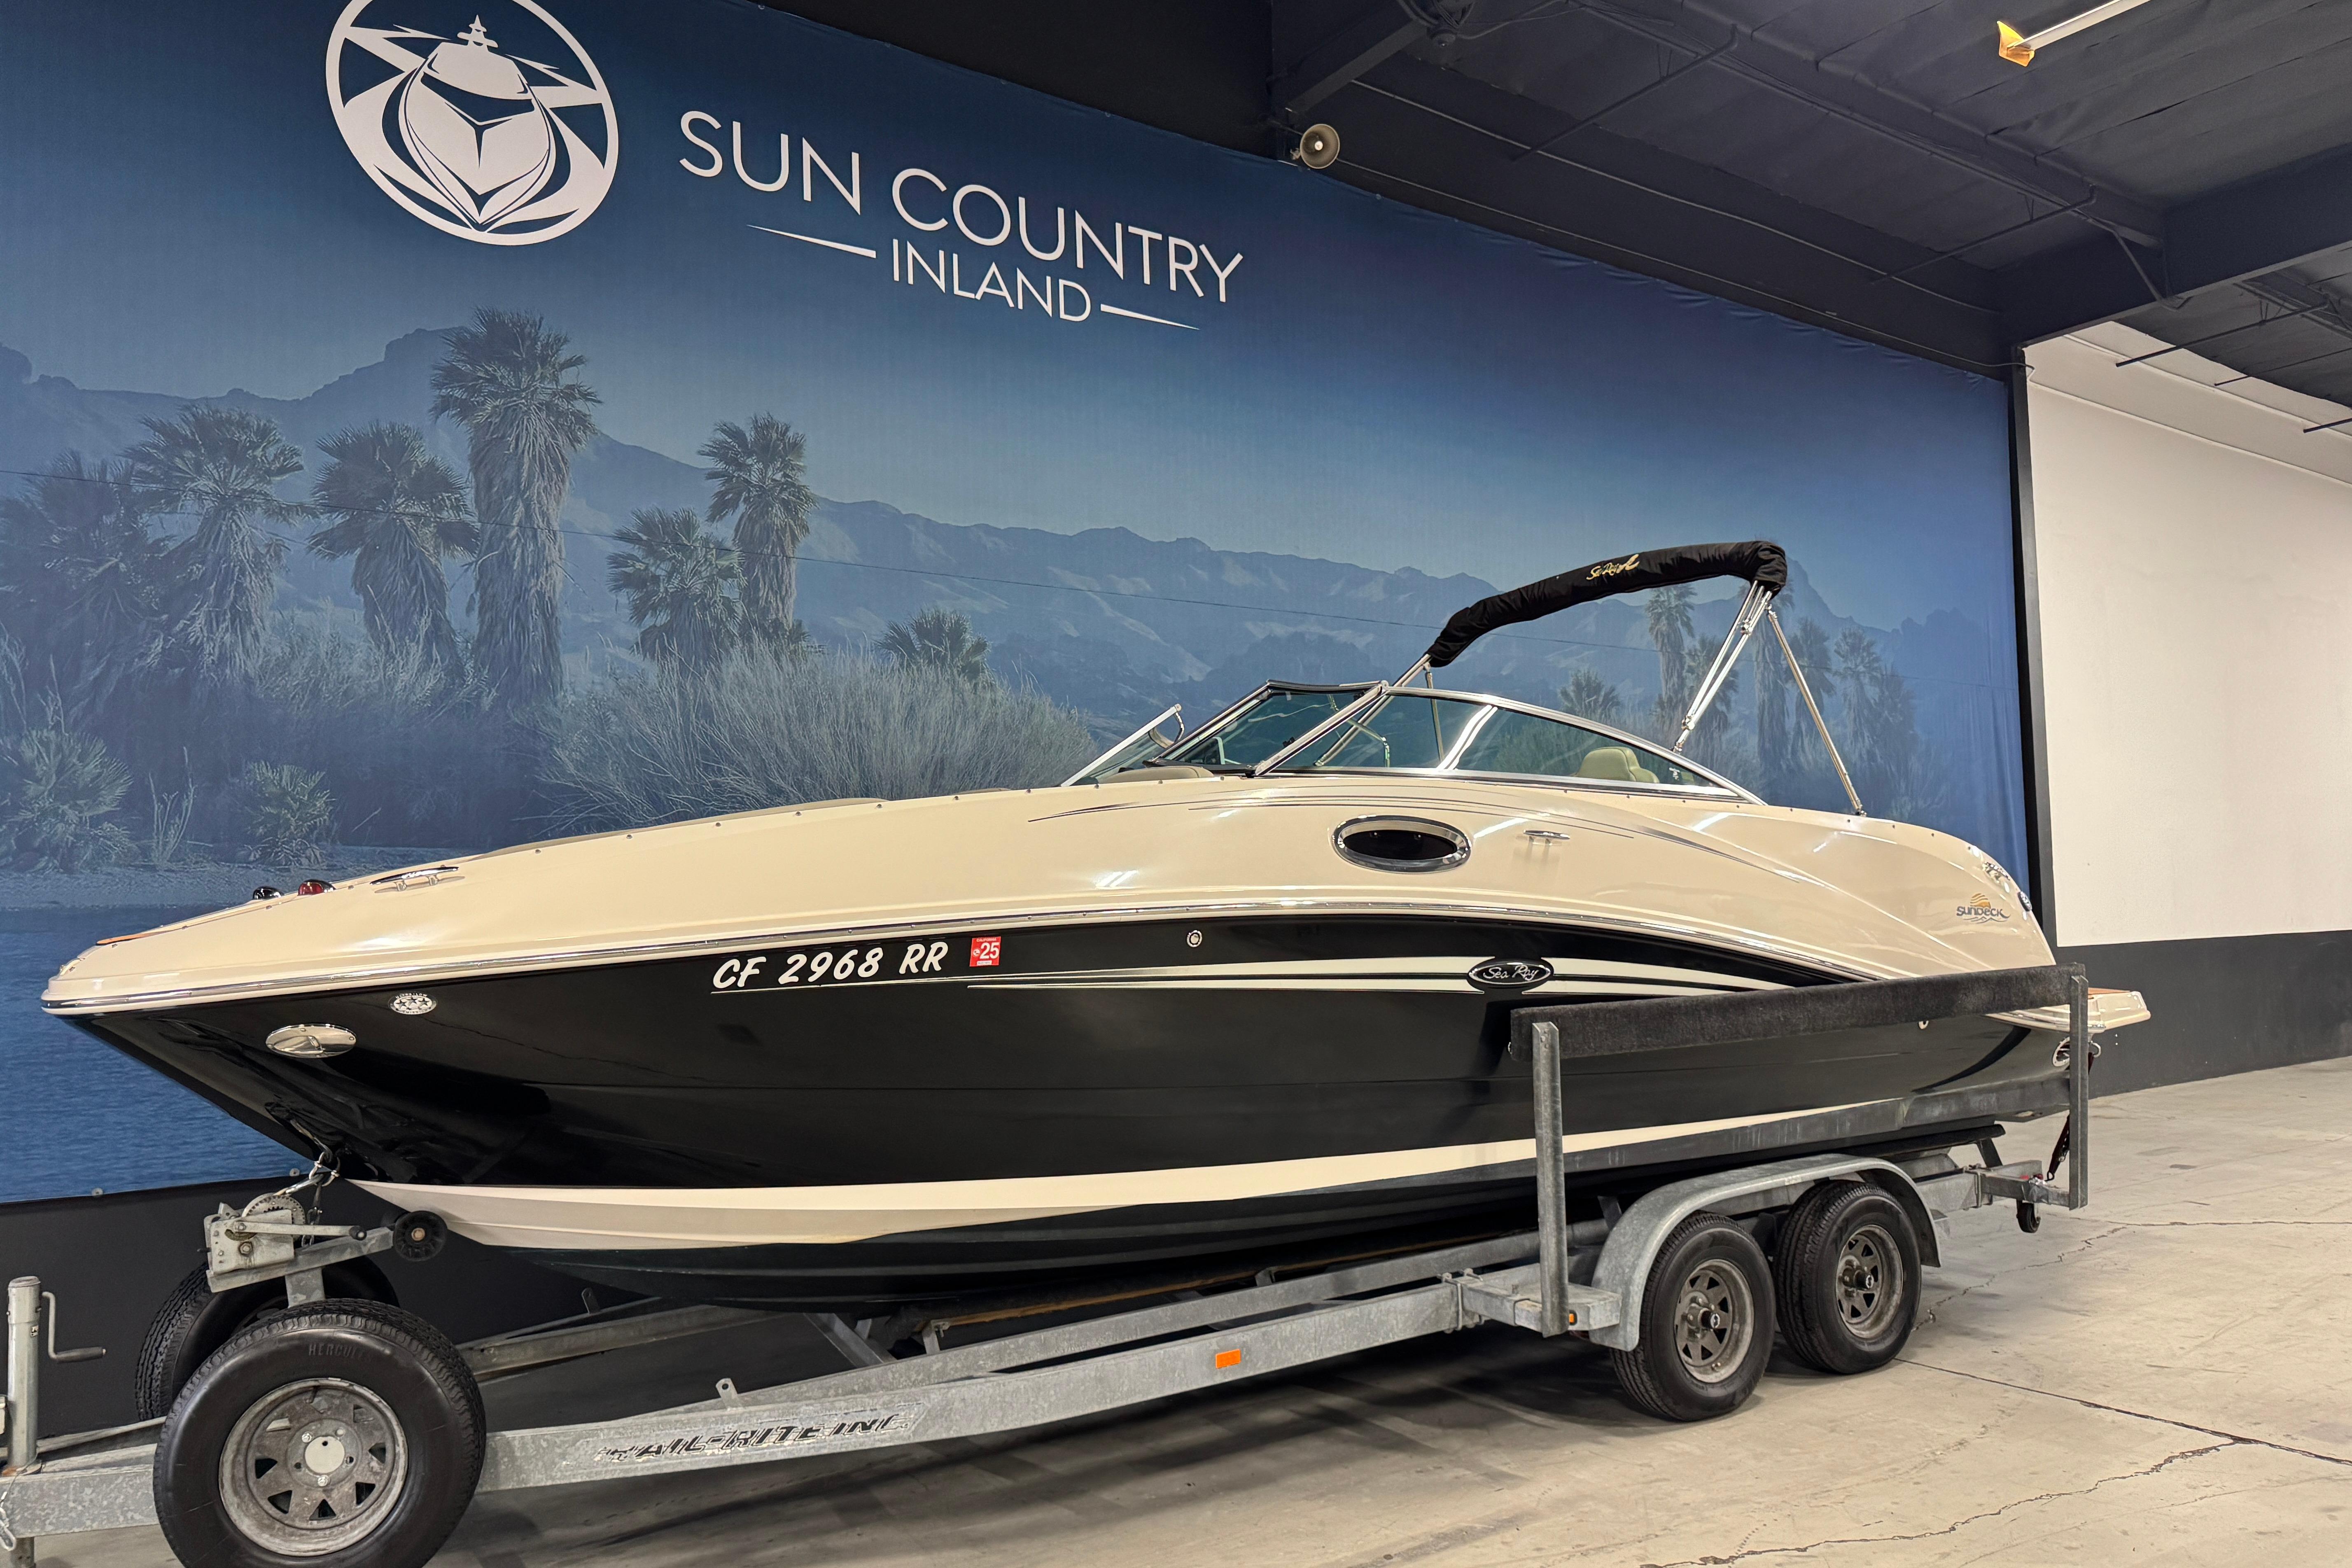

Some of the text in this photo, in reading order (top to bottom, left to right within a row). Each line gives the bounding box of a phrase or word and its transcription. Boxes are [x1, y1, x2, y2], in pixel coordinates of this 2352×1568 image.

[679, 110, 1244, 303] SUN COUNTRY
[892, 238, 1091, 322] INLAND
[712, 941, 948, 989] CF 2968 RR
[980, 942, 1000, 959] 25
[1483, 965, 1540, 981] Sea Ray
[308, 1343, 372, 1363] HERCUL
